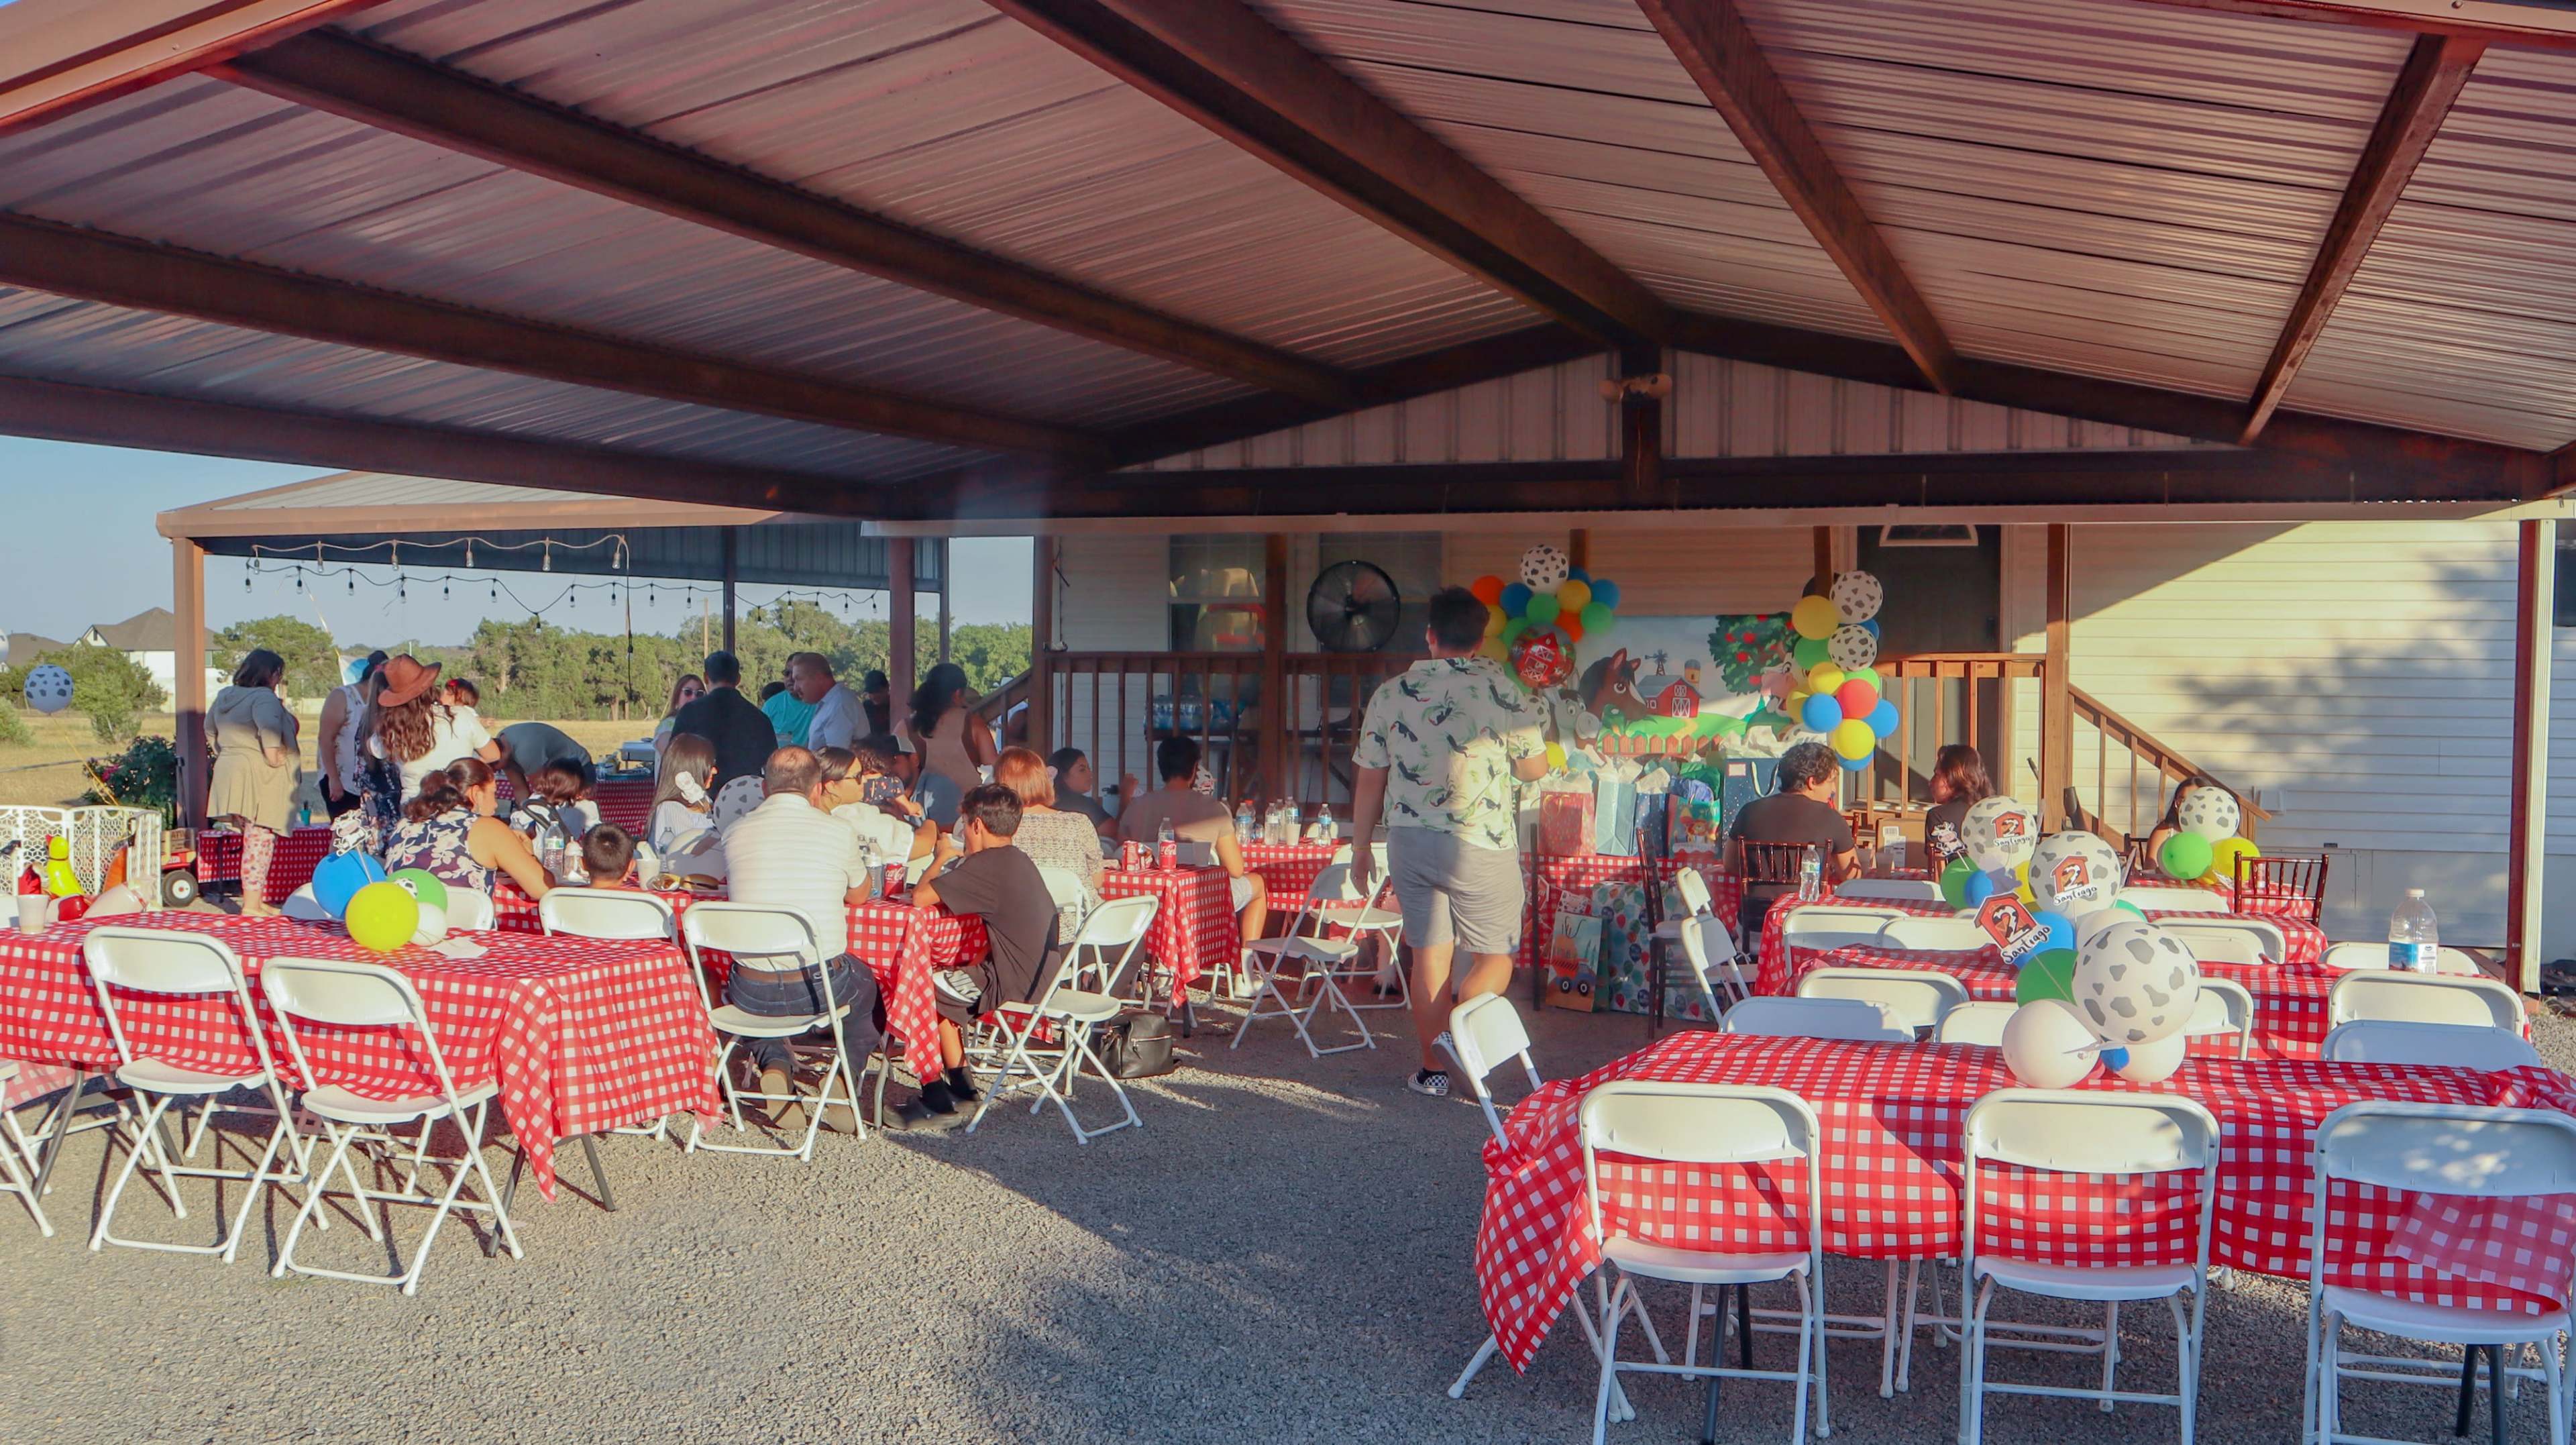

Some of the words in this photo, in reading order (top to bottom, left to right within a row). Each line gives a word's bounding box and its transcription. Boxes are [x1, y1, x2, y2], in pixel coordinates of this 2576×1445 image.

[2001, 817, 2021, 839] 2
[1994, 837, 2031, 847] Santiago
[2061, 863, 2084, 892] 2
[2054, 886, 2098, 905] Santiago
[1992, 904, 2033, 945] 2
[2002, 926, 2051, 963] Santiago
